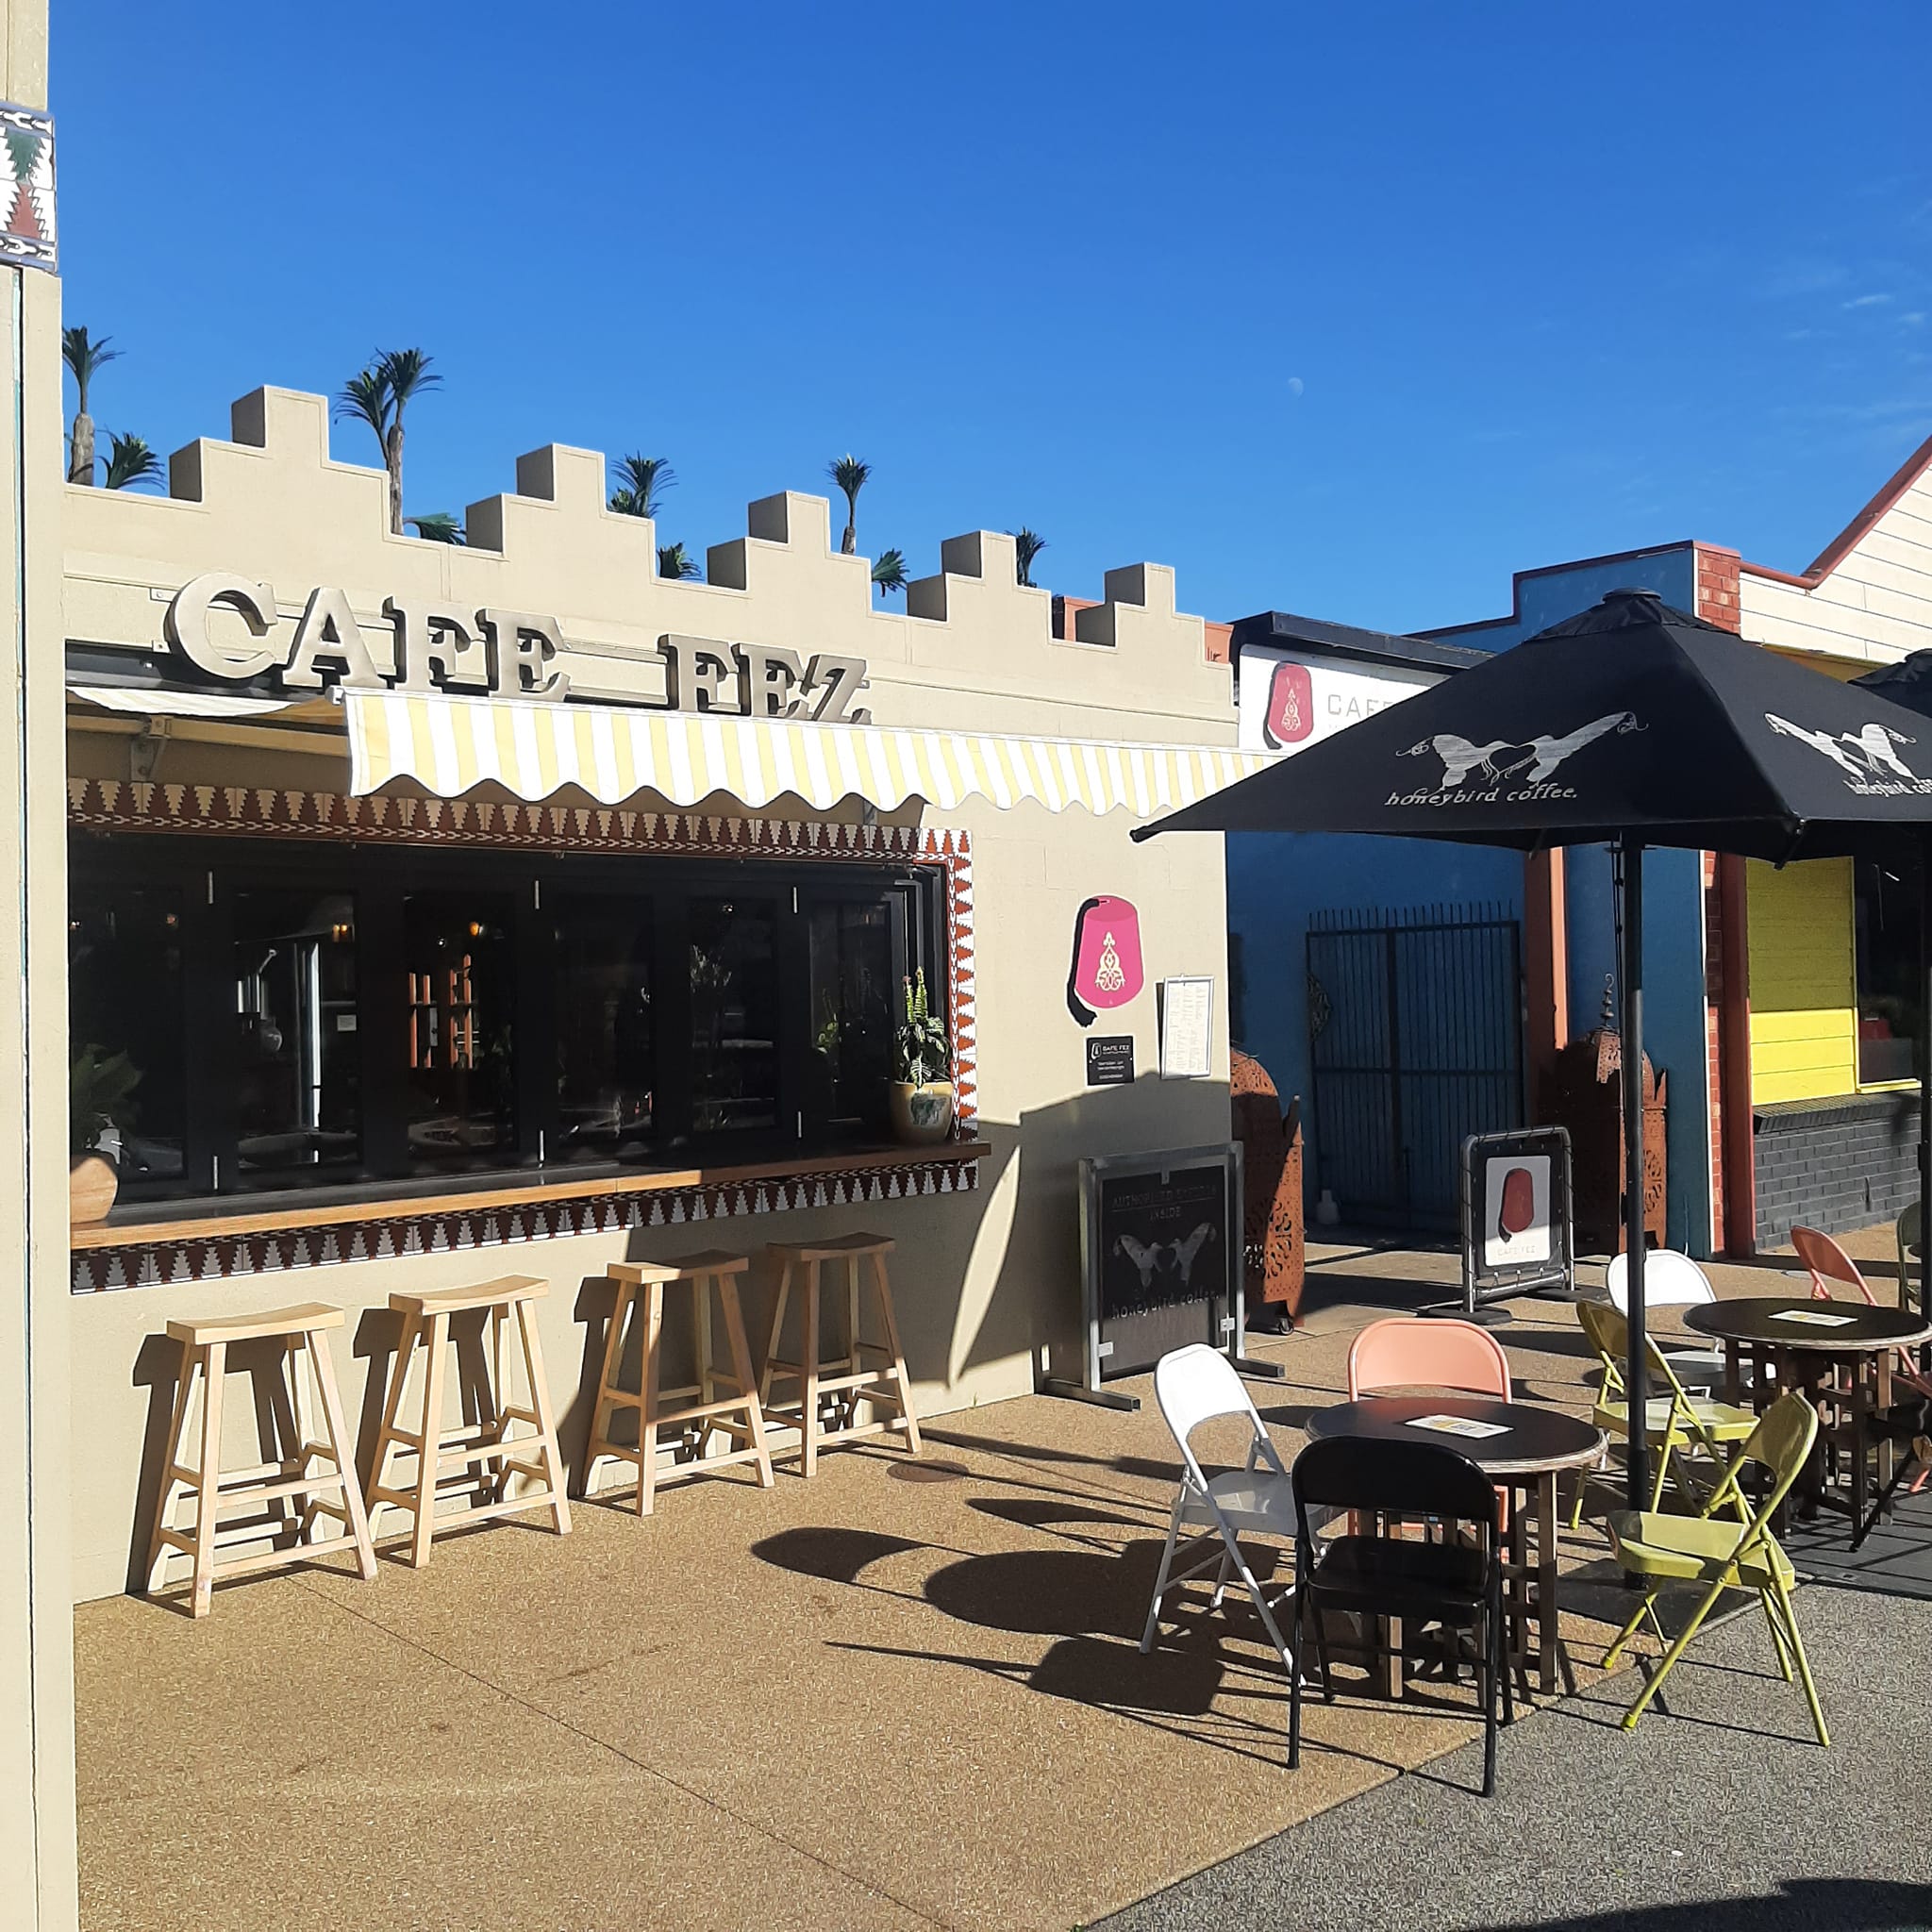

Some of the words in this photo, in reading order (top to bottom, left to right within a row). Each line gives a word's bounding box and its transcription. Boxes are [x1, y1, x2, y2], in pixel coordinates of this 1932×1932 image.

[165, 572, 571, 703] CAFE
[658, 633, 873, 724] FEZ
[1384, 787, 1500, 807] honeybird
